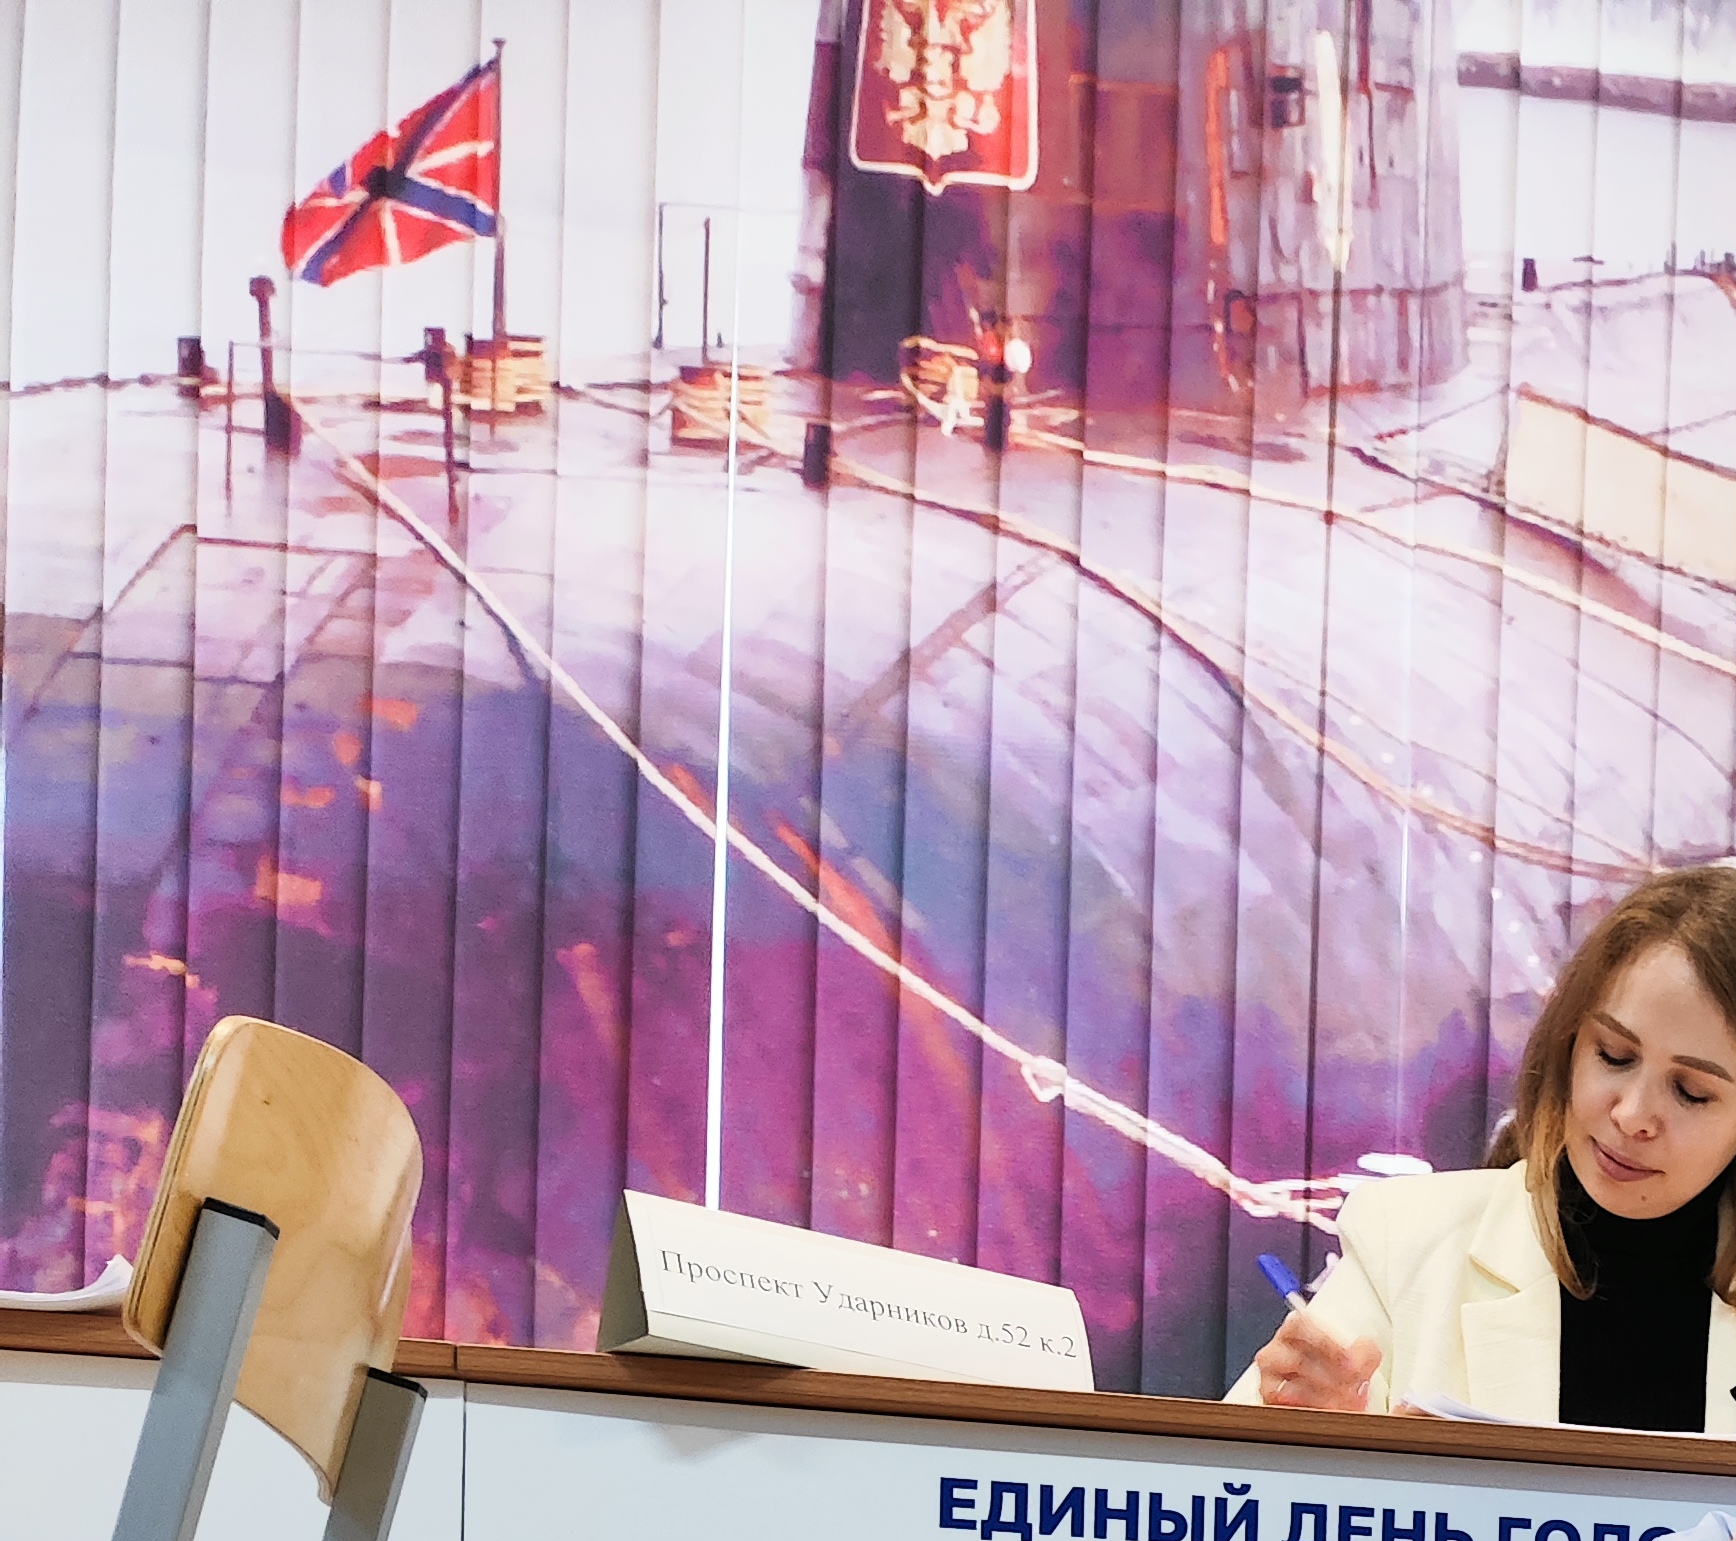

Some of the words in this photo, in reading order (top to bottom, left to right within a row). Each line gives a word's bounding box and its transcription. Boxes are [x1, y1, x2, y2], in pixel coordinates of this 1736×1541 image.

[659, 1249, 803, 1298] Проспект
[811, 1281, 968, 1334] Ударников
[977, 1323, 1032, 1349] д.52
[1040, 1336, 1077, 1359] к.2
